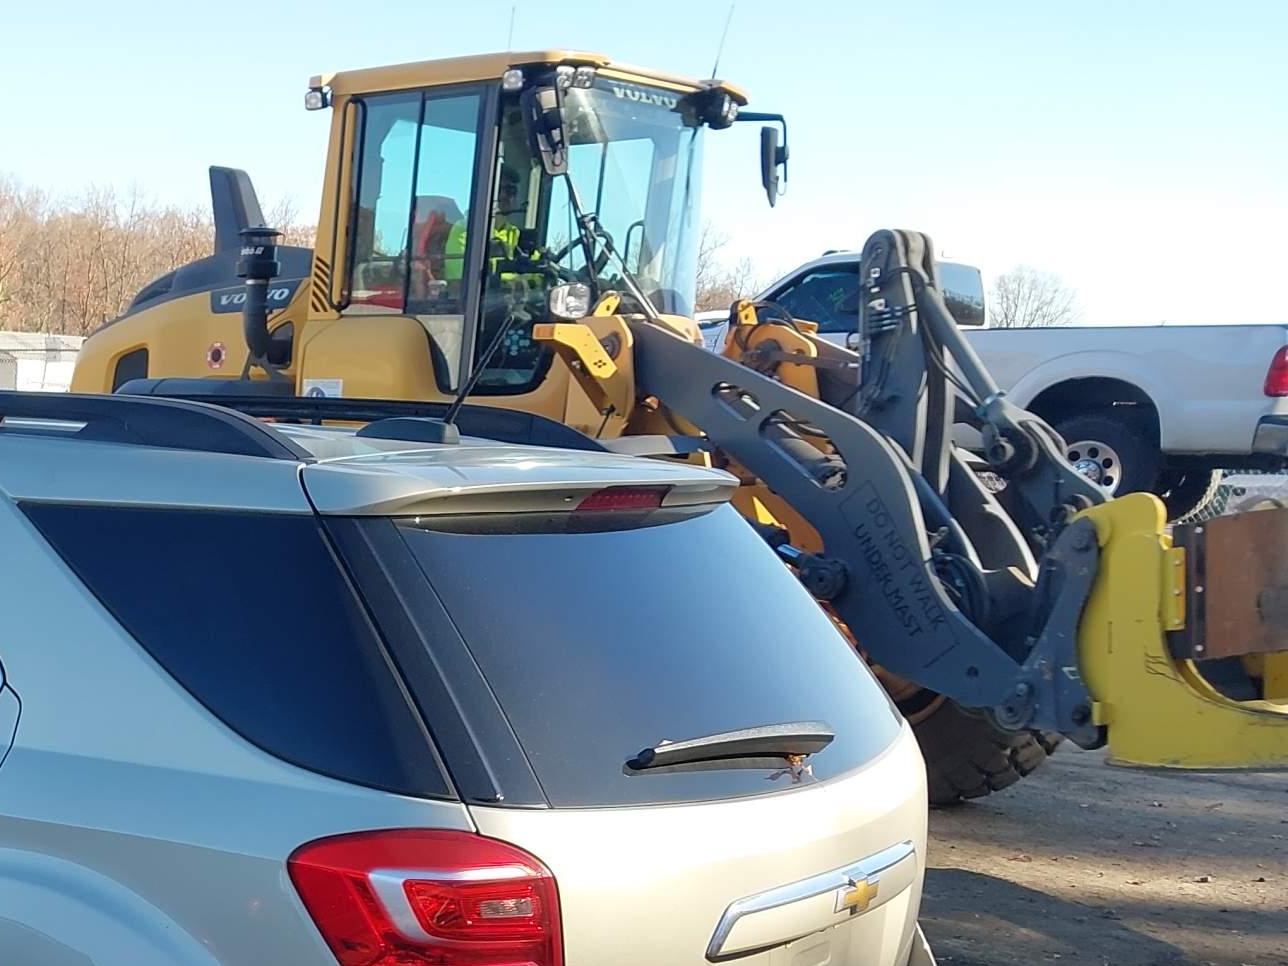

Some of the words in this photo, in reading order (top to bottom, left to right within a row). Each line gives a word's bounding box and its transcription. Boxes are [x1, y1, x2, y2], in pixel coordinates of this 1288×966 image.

[612, 87, 677, 109] VOLVO
[219, 287, 291, 306] VOVO
[865, 497, 888, 528] DO
[882, 529, 914, 571] NOT
[908, 571, 946, 632] WALK
